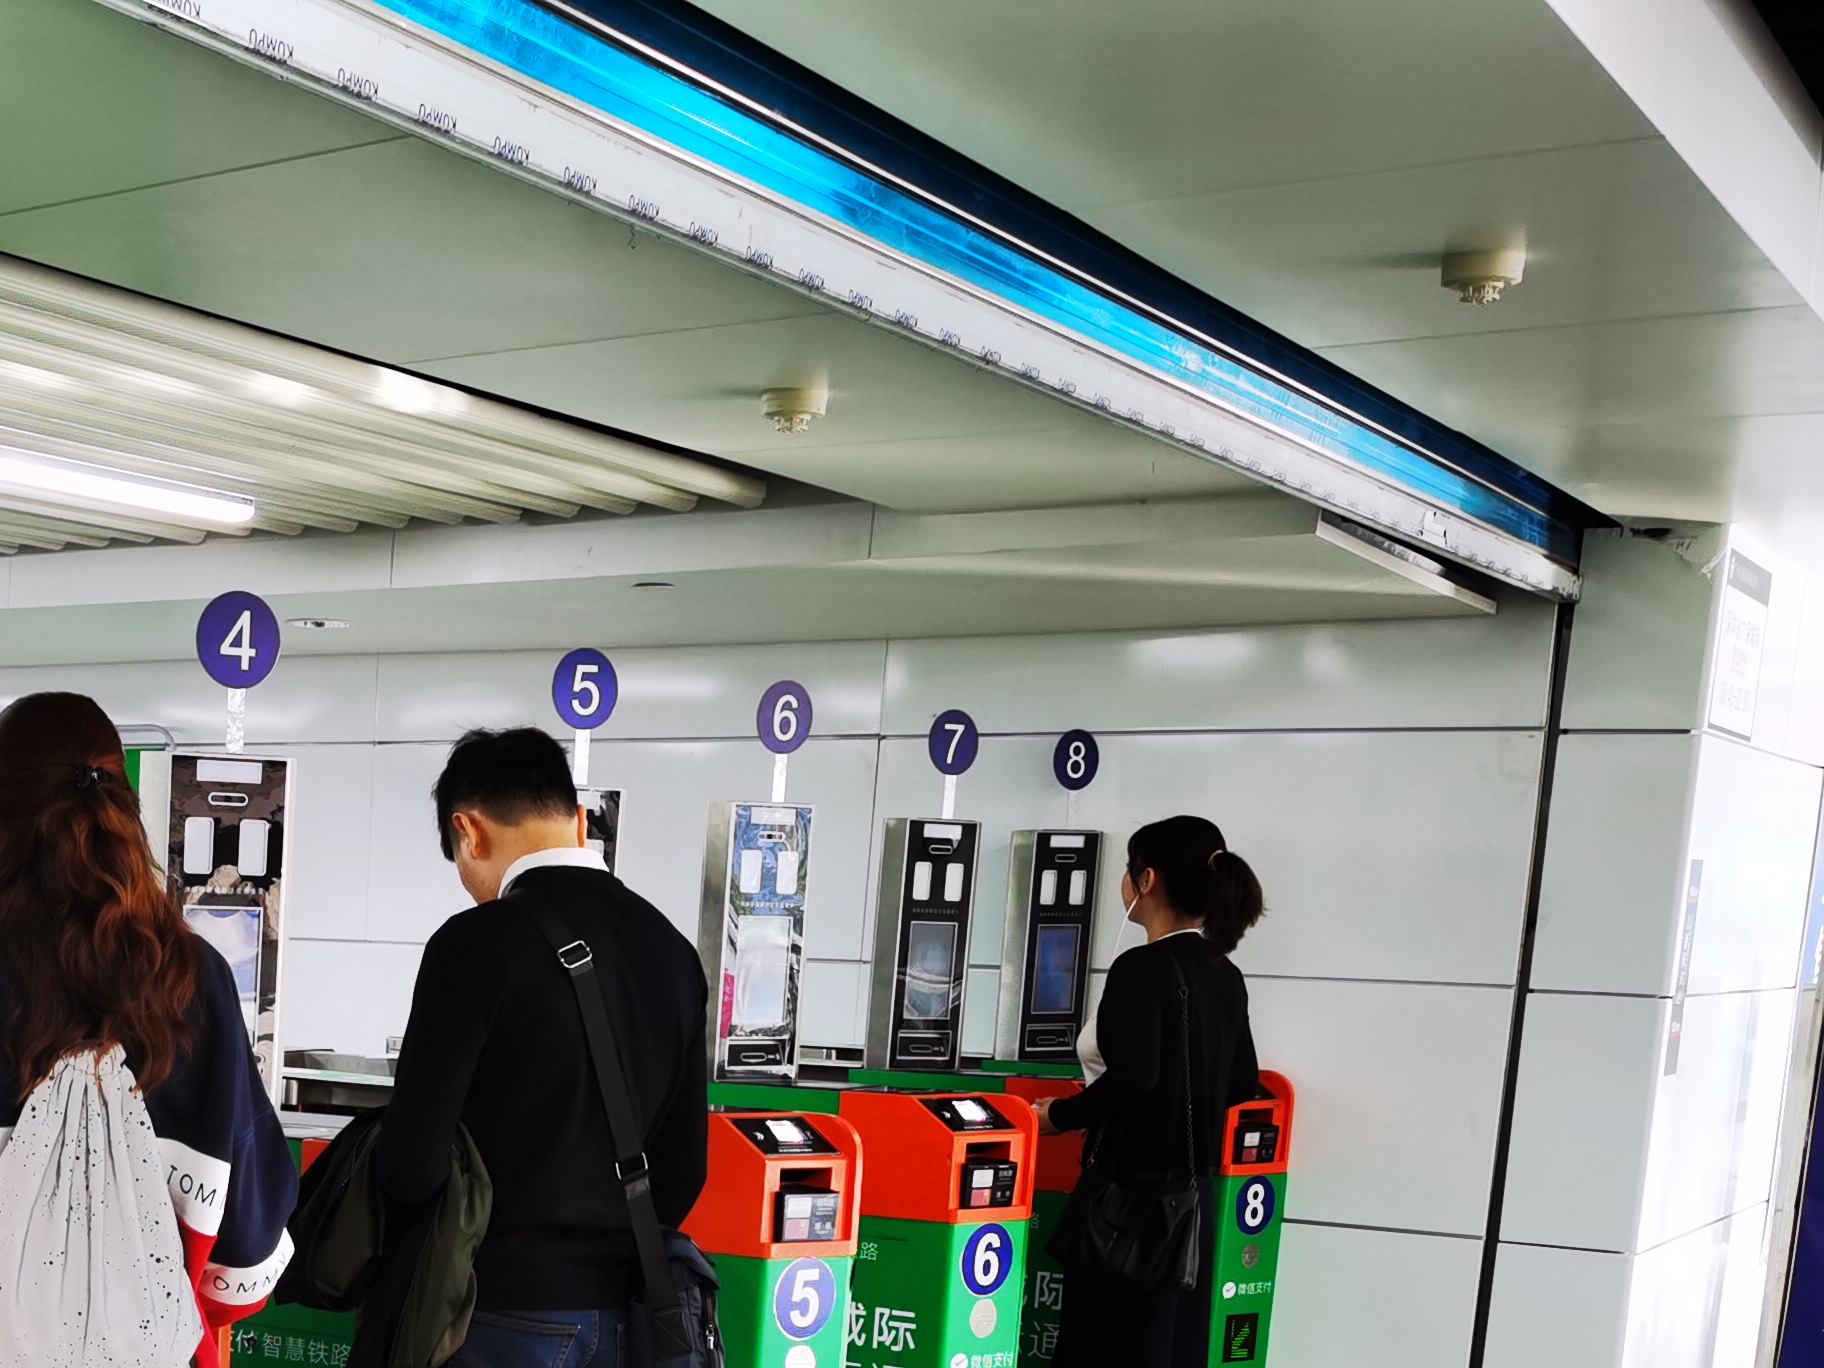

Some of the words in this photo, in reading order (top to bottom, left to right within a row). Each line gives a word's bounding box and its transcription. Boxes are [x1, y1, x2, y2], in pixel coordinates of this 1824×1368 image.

[219, 611, 256, 671] 4
[571, 665, 600, 716] 5
[772, 694, 798, 741] 6
[944, 724, 966, 764] 7
[1066, 742, 1085, 778] 8
[167, 1165, 226, 1210] TOM
[1244, 1184, 1264, 1227] 8
[205, 1253, 286, 1294] OMMY
[974, 1232, 1001, 1287] 6
[790, 1268, 821, 1329] 5
[229, 1328, 351, 1368] 付智慧铁路
